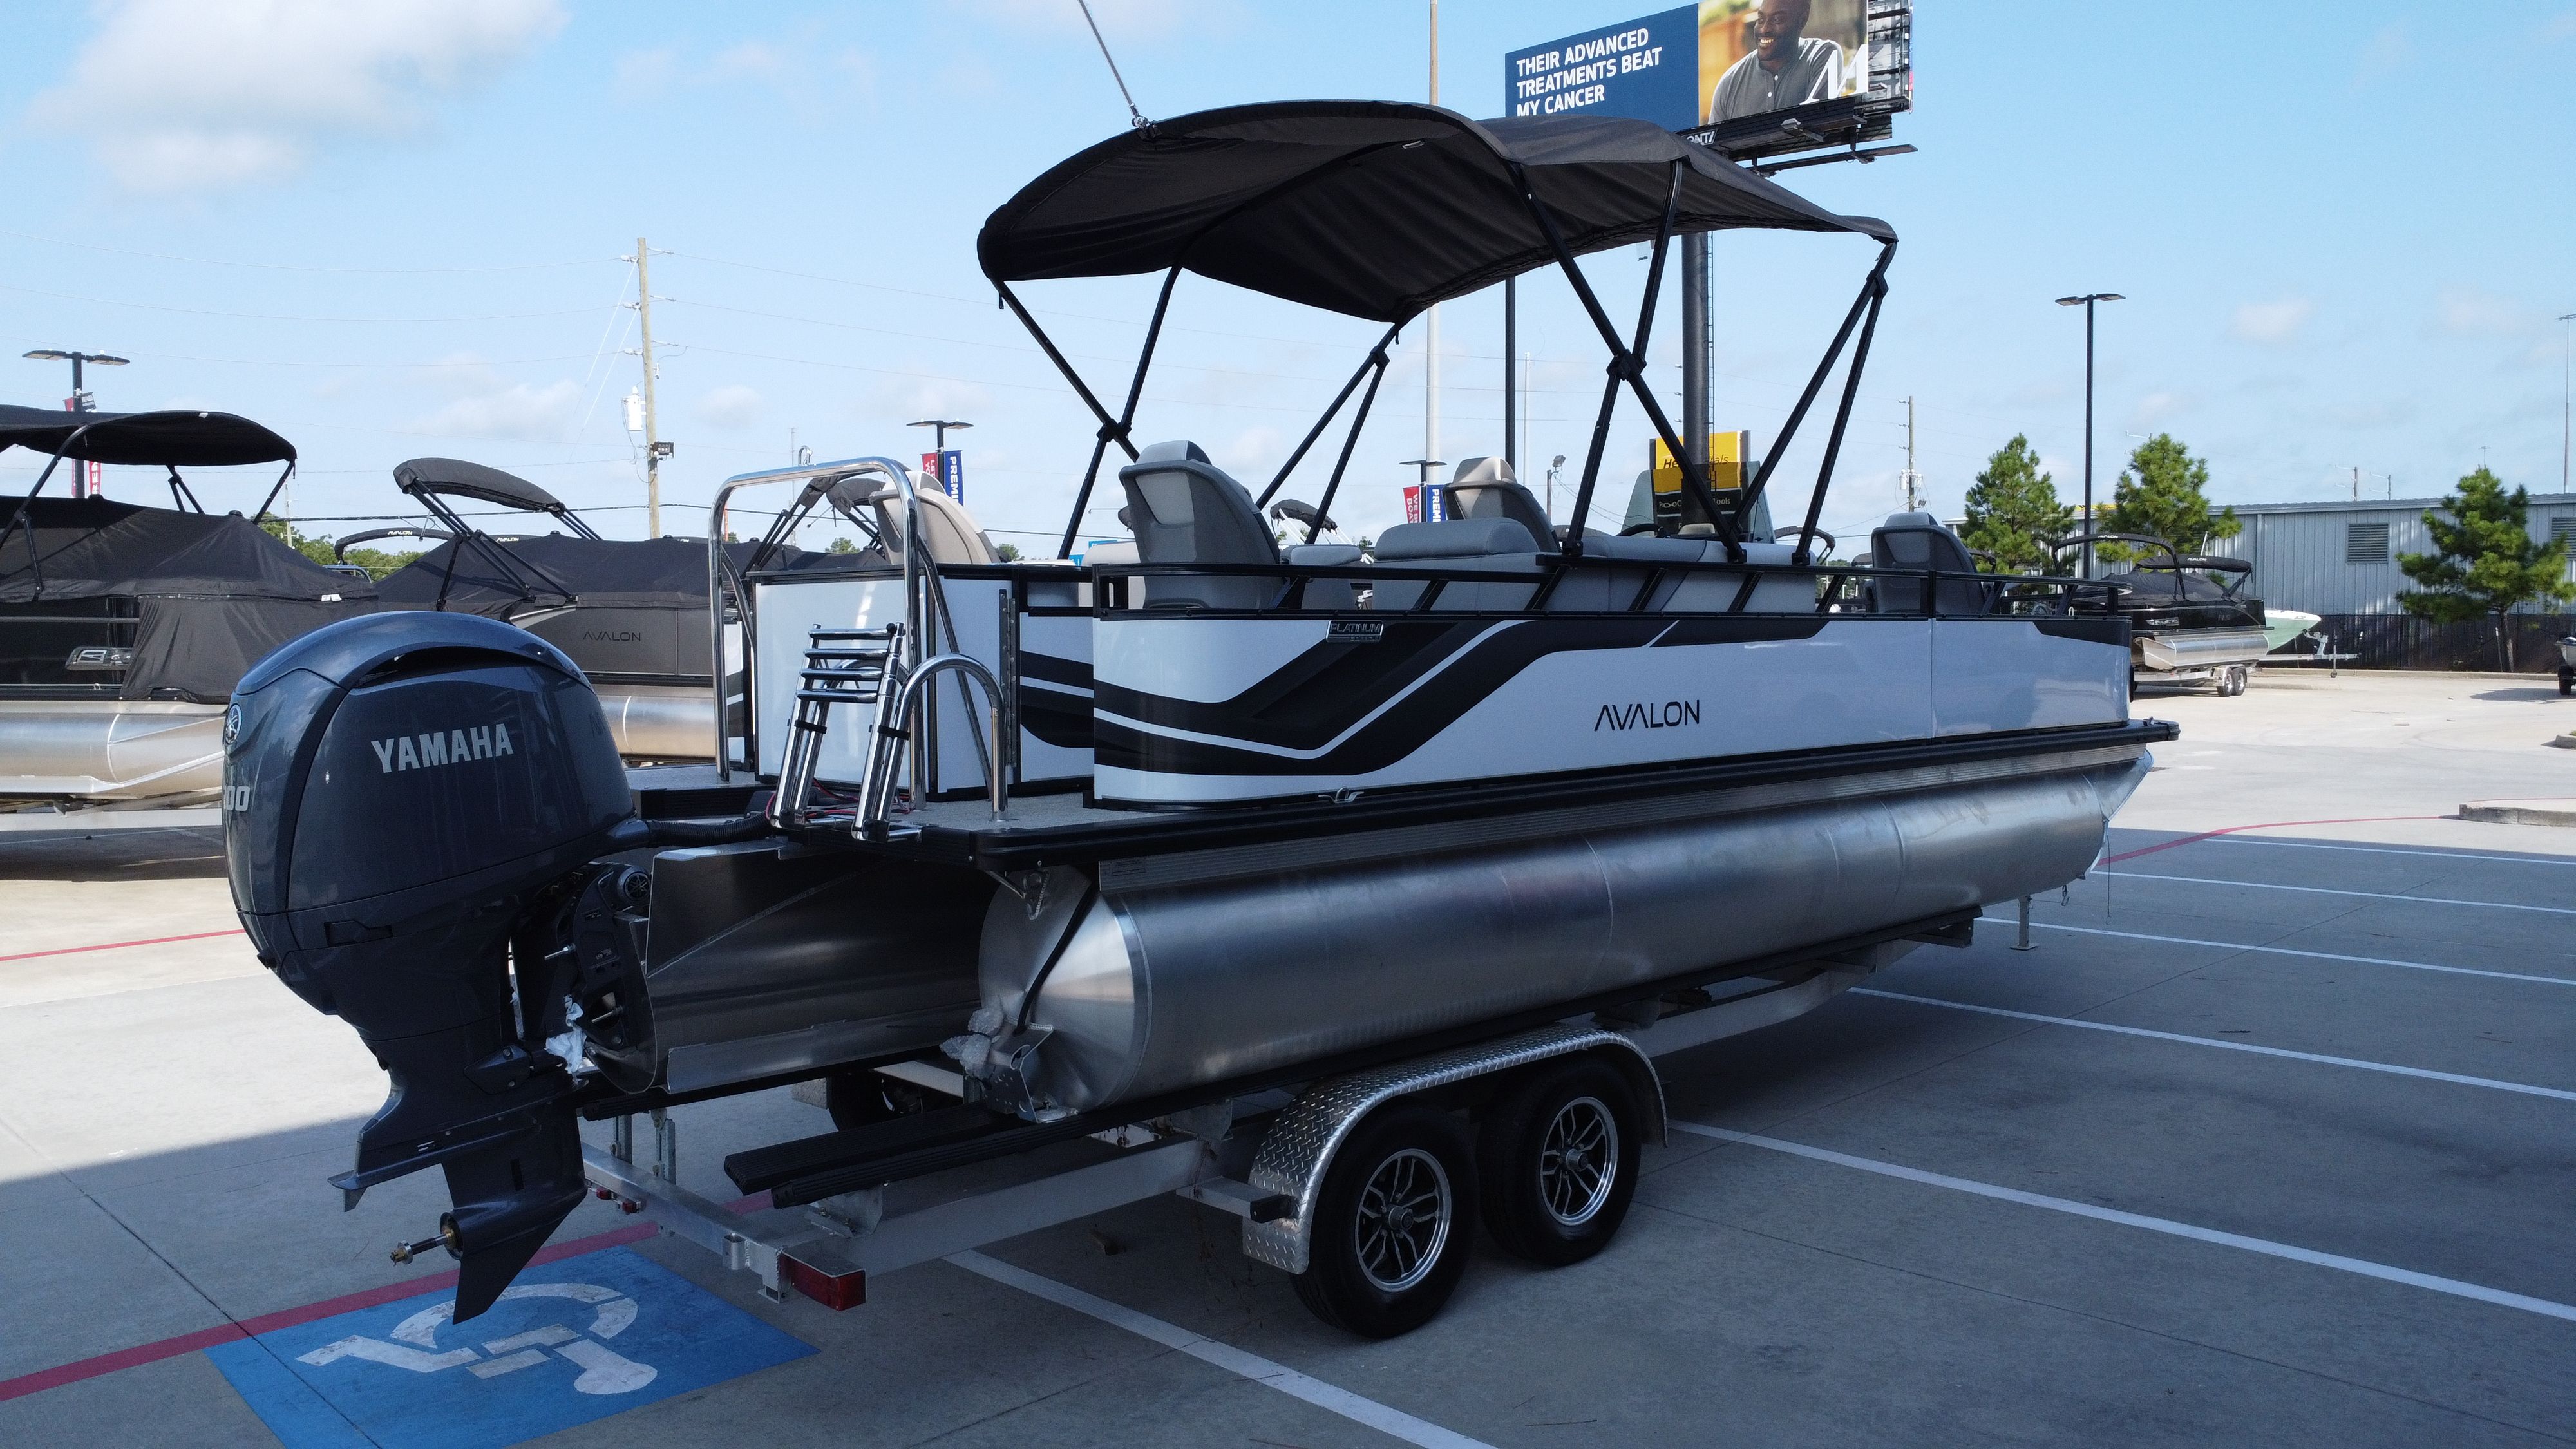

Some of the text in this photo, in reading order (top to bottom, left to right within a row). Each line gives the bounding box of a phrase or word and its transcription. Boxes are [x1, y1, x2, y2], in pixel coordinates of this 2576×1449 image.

[1517, 28, 1649, 77] THEIR ADVANCED
[1516, 47, 1662, 99] TREATMENTS BEAT
[1517, 84, 1605, 117] MY CANCER
[582, 631, 641, 641] AVALON
[1330, 623, 1381, 633] PLATINUM
[1594, 699, 1700, 732] AVALON
[371, 723, 514, 773] YAMAHA
